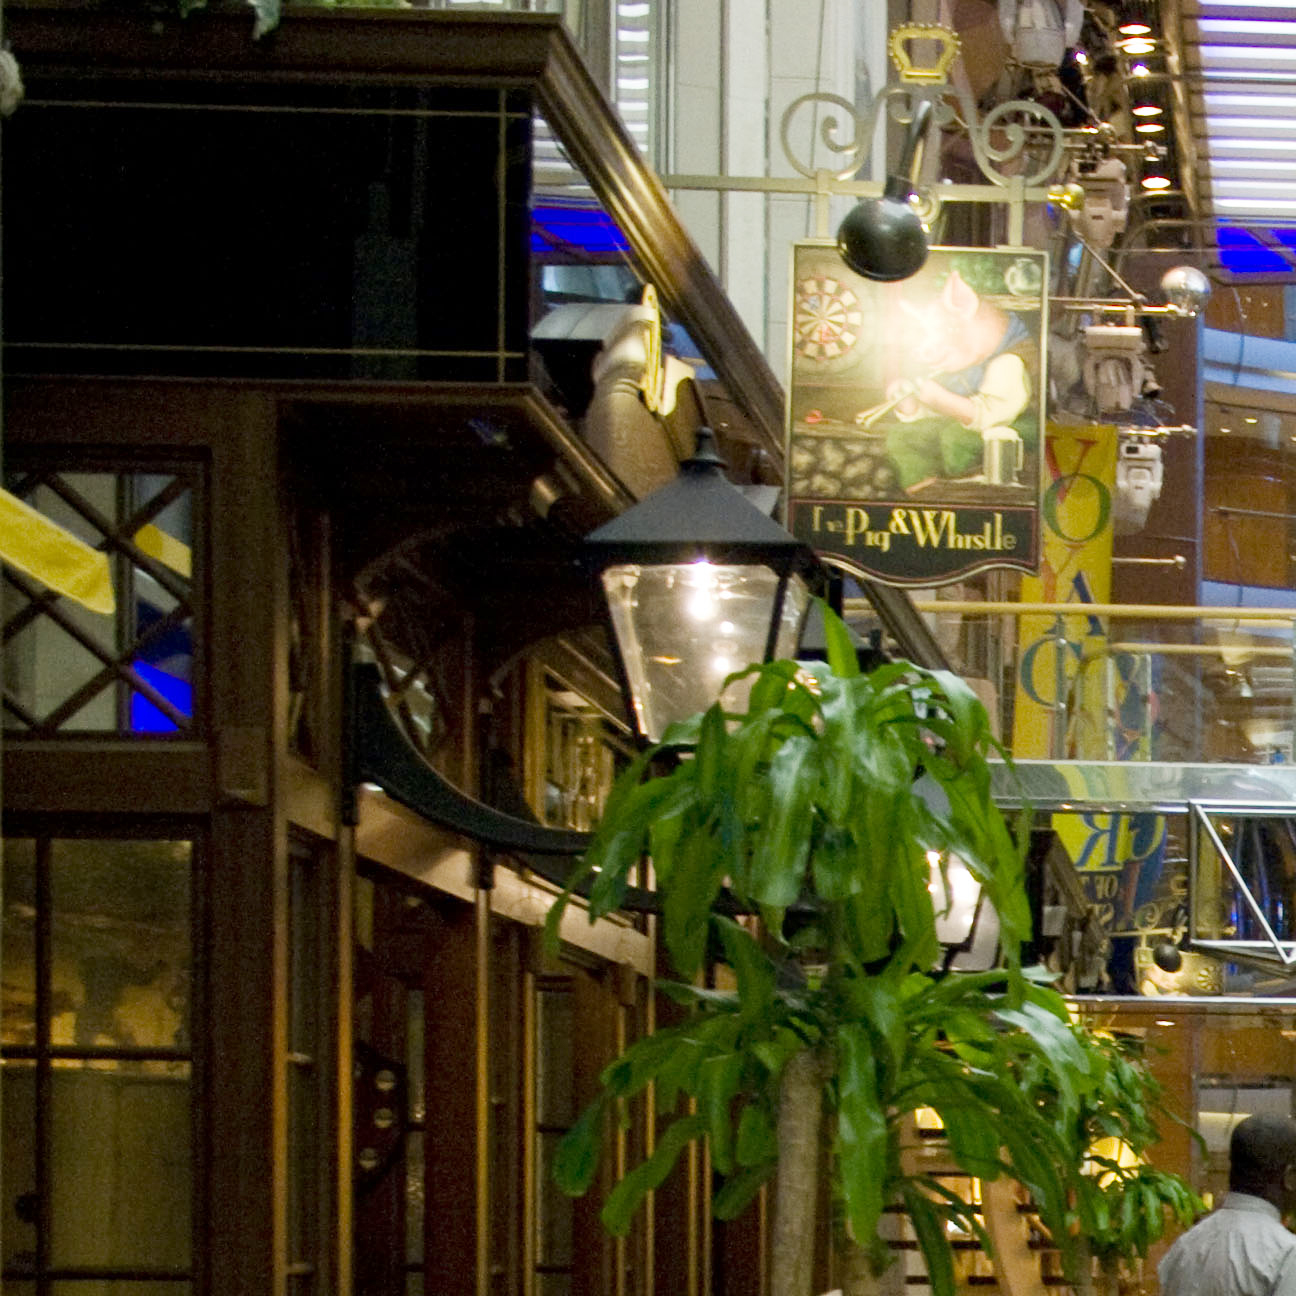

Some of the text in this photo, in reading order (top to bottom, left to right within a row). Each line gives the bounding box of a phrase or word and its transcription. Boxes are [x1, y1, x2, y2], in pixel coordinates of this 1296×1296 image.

[845, 507, 890, 552] Pig
[888, 508, 911, 534] &
[909, 510, 1017, 551] Whistle
